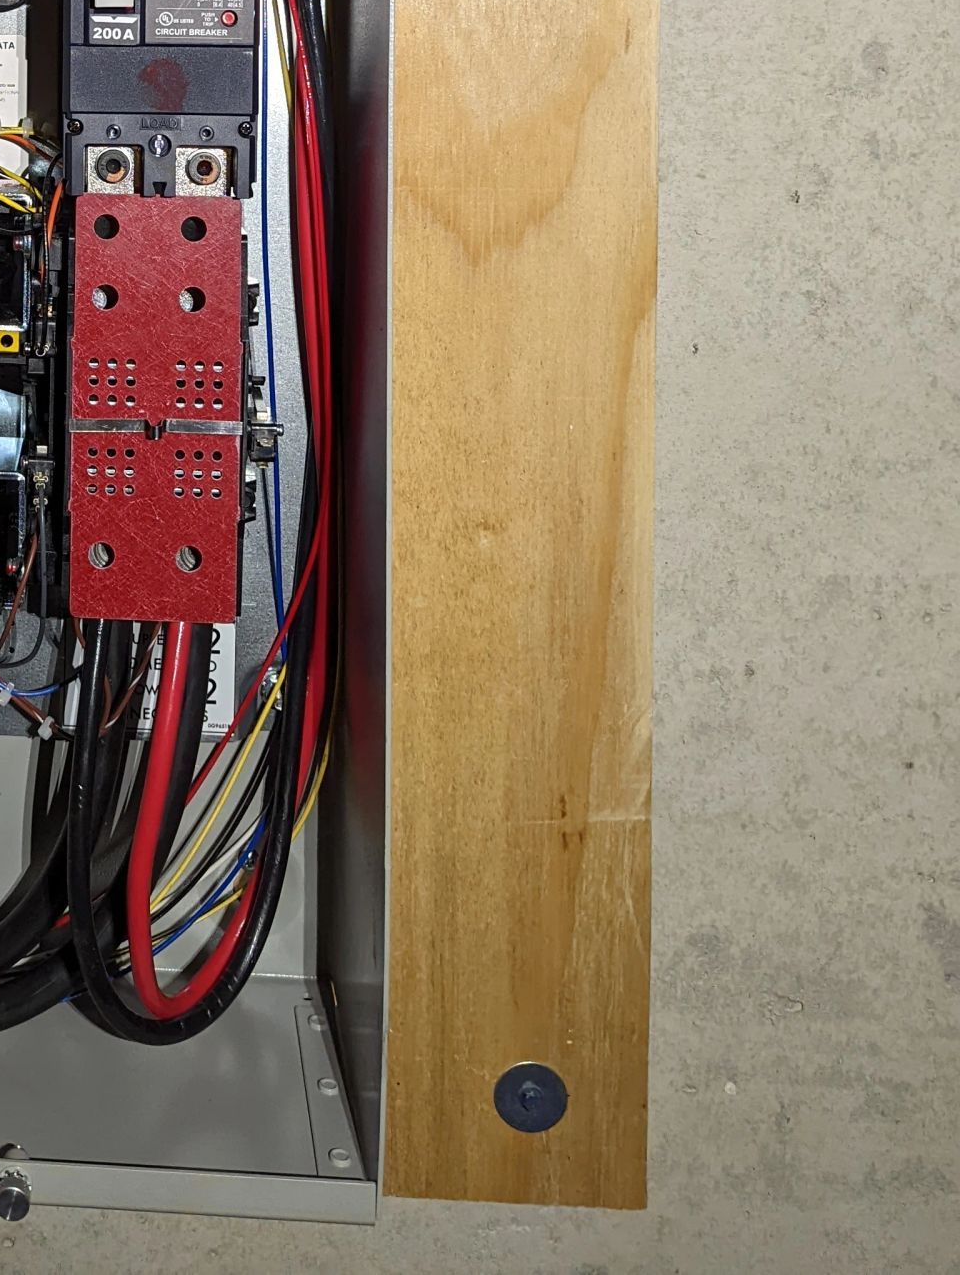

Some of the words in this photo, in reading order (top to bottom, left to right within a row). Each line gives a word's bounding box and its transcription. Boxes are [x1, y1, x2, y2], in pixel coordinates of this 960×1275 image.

[93, 27, 121, 40] 200
[123, 28, 135, 40] A
[142, 117, 178, 129] LOAD
